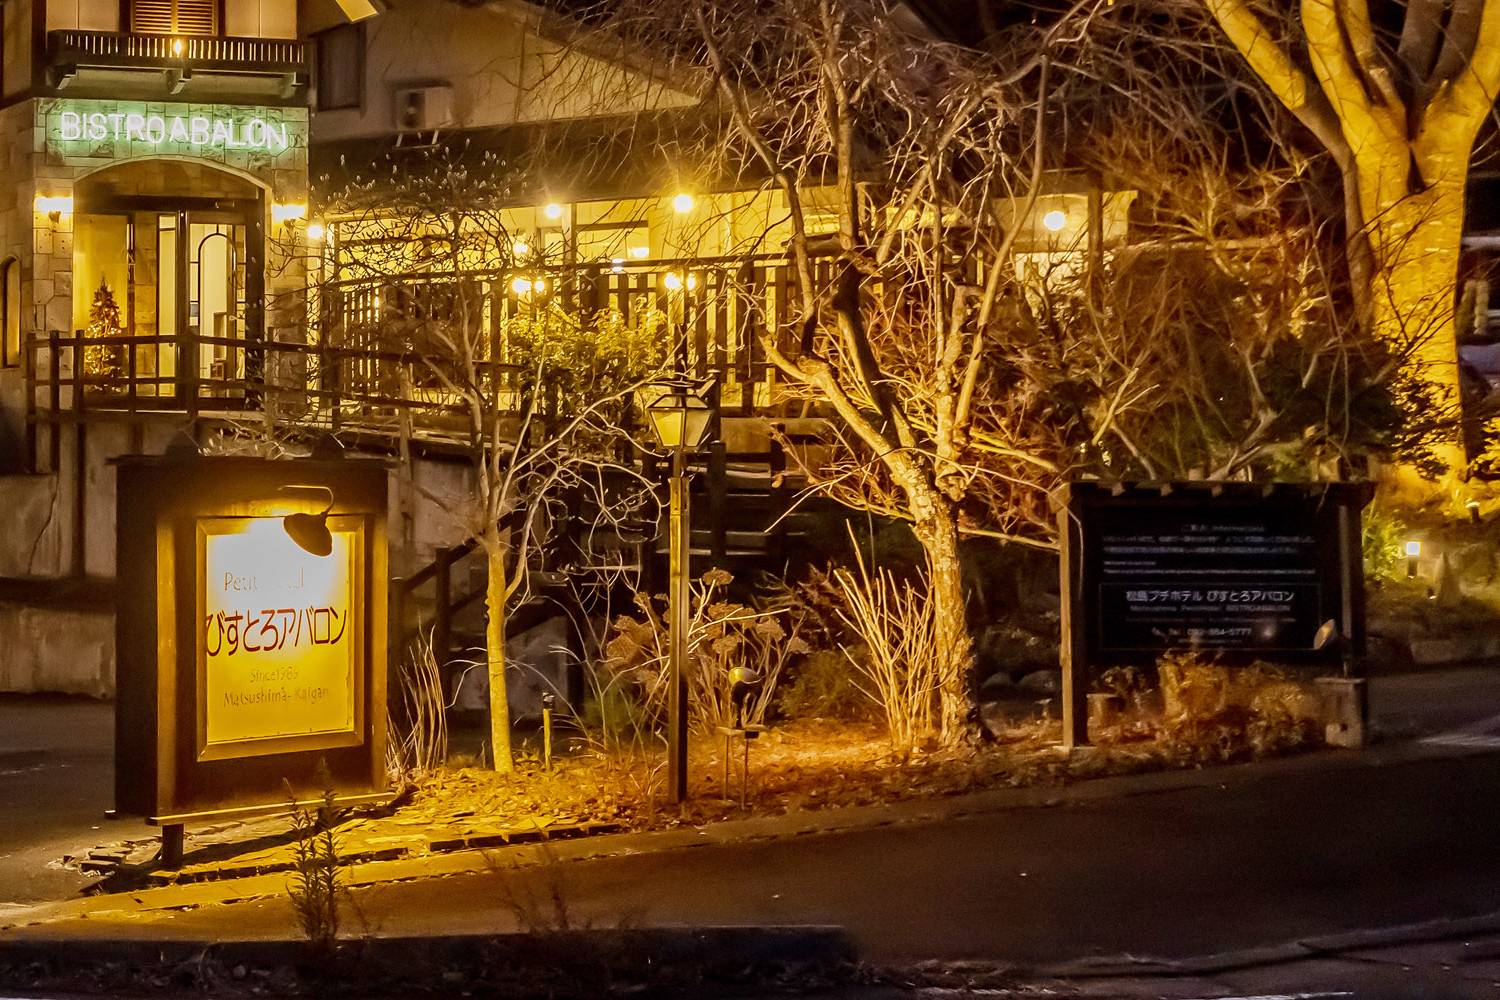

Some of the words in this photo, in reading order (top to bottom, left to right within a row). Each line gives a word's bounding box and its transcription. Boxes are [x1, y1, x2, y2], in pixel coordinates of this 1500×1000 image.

[206, 605, 347, 657] びすとろアバロン
